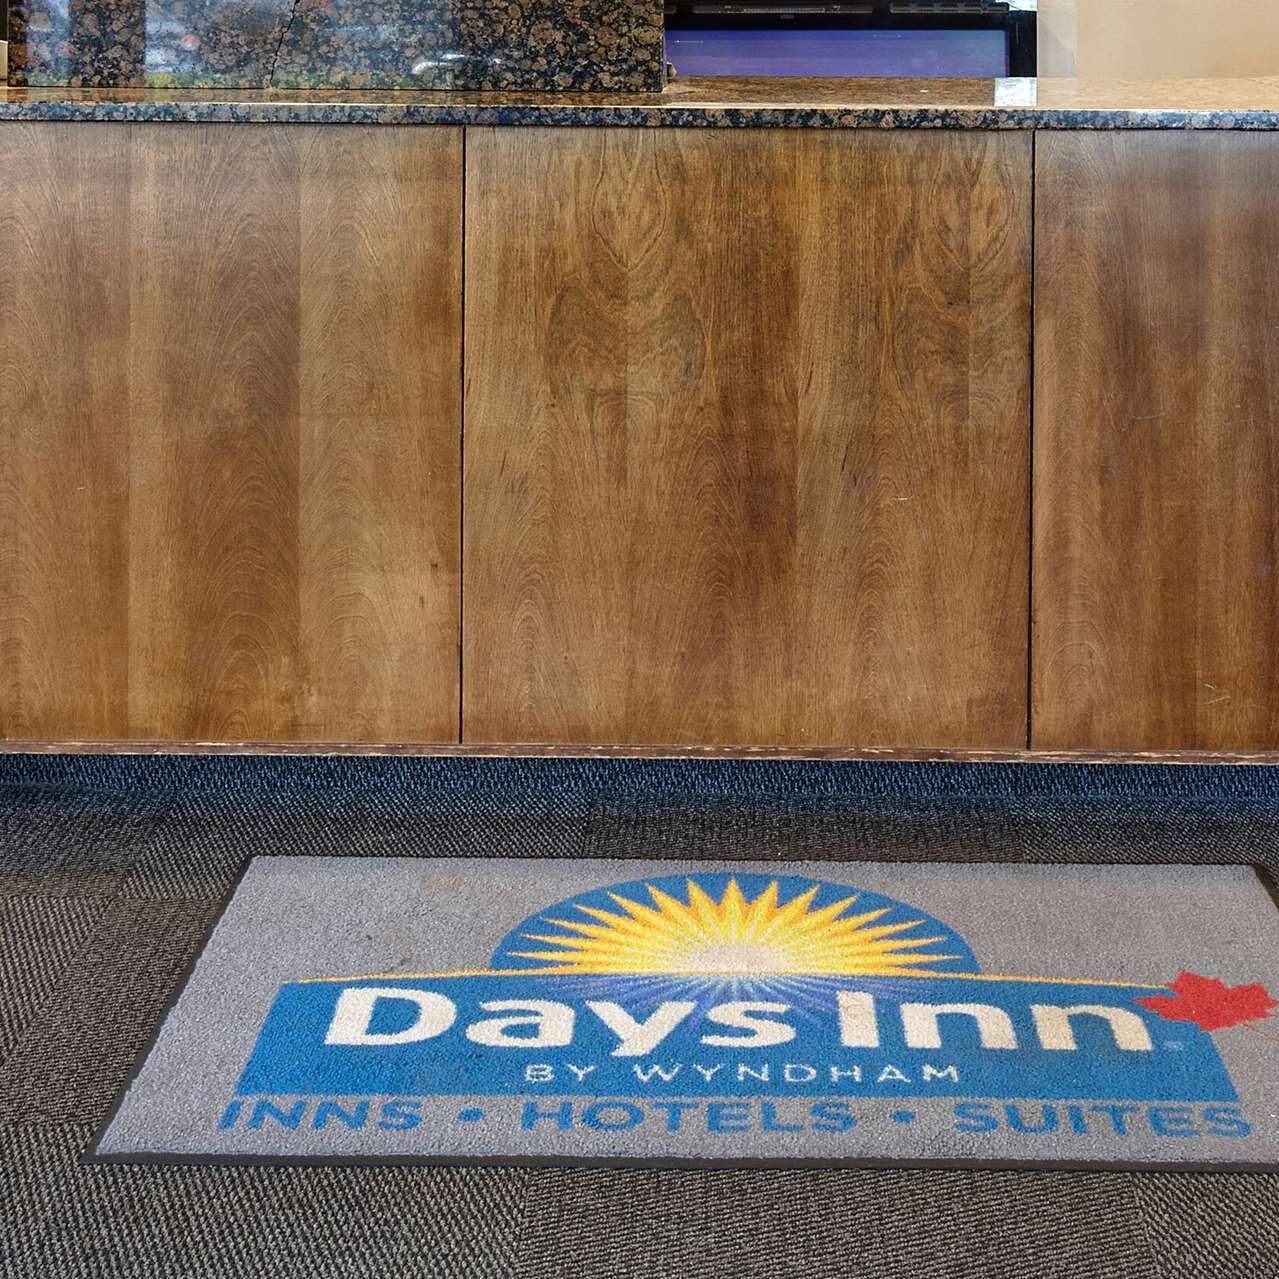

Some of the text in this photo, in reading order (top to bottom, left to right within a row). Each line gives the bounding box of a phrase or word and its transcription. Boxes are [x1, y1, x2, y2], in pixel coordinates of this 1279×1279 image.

[324, 987, 1153, 1056] Days Inn
[523, 1063, 961, 1083] BY WYNDHAM
[219, 1100, 1255, 1138] INNS HOTELS SUITES
